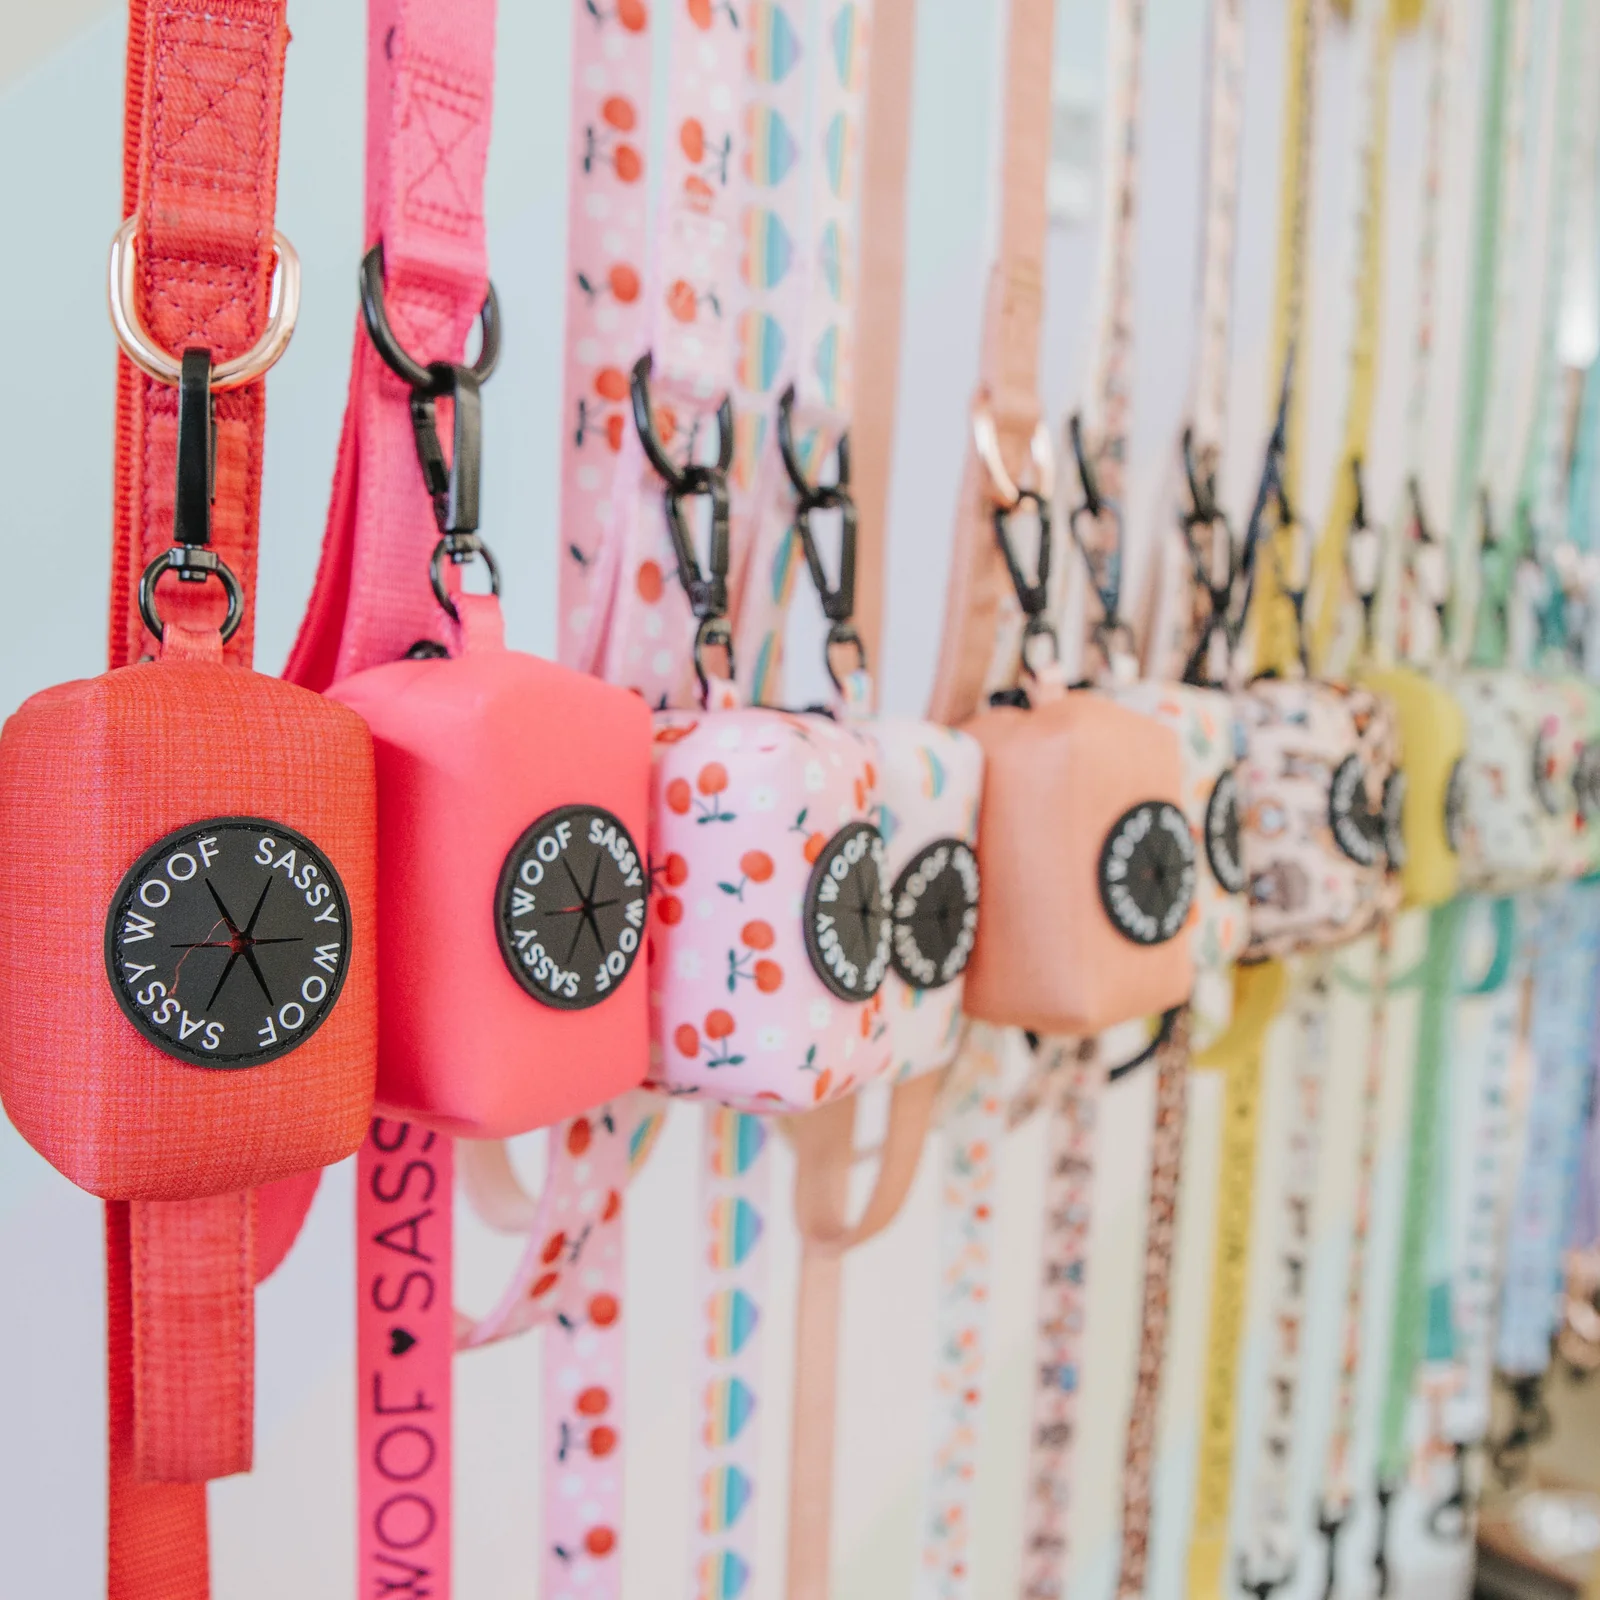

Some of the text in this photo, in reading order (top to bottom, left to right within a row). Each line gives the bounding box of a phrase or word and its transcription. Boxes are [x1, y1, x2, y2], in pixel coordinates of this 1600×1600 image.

[123, 837, 224, 1050] SASSY WOOF
[254, 838, 340, 1047] SASSY WOOF
[512, 821, 580, 997] SASSY WOOF
[588, 818, 644, 991] SASSY WOOF
[816, 831, 870, 988] SASSY WOOF
